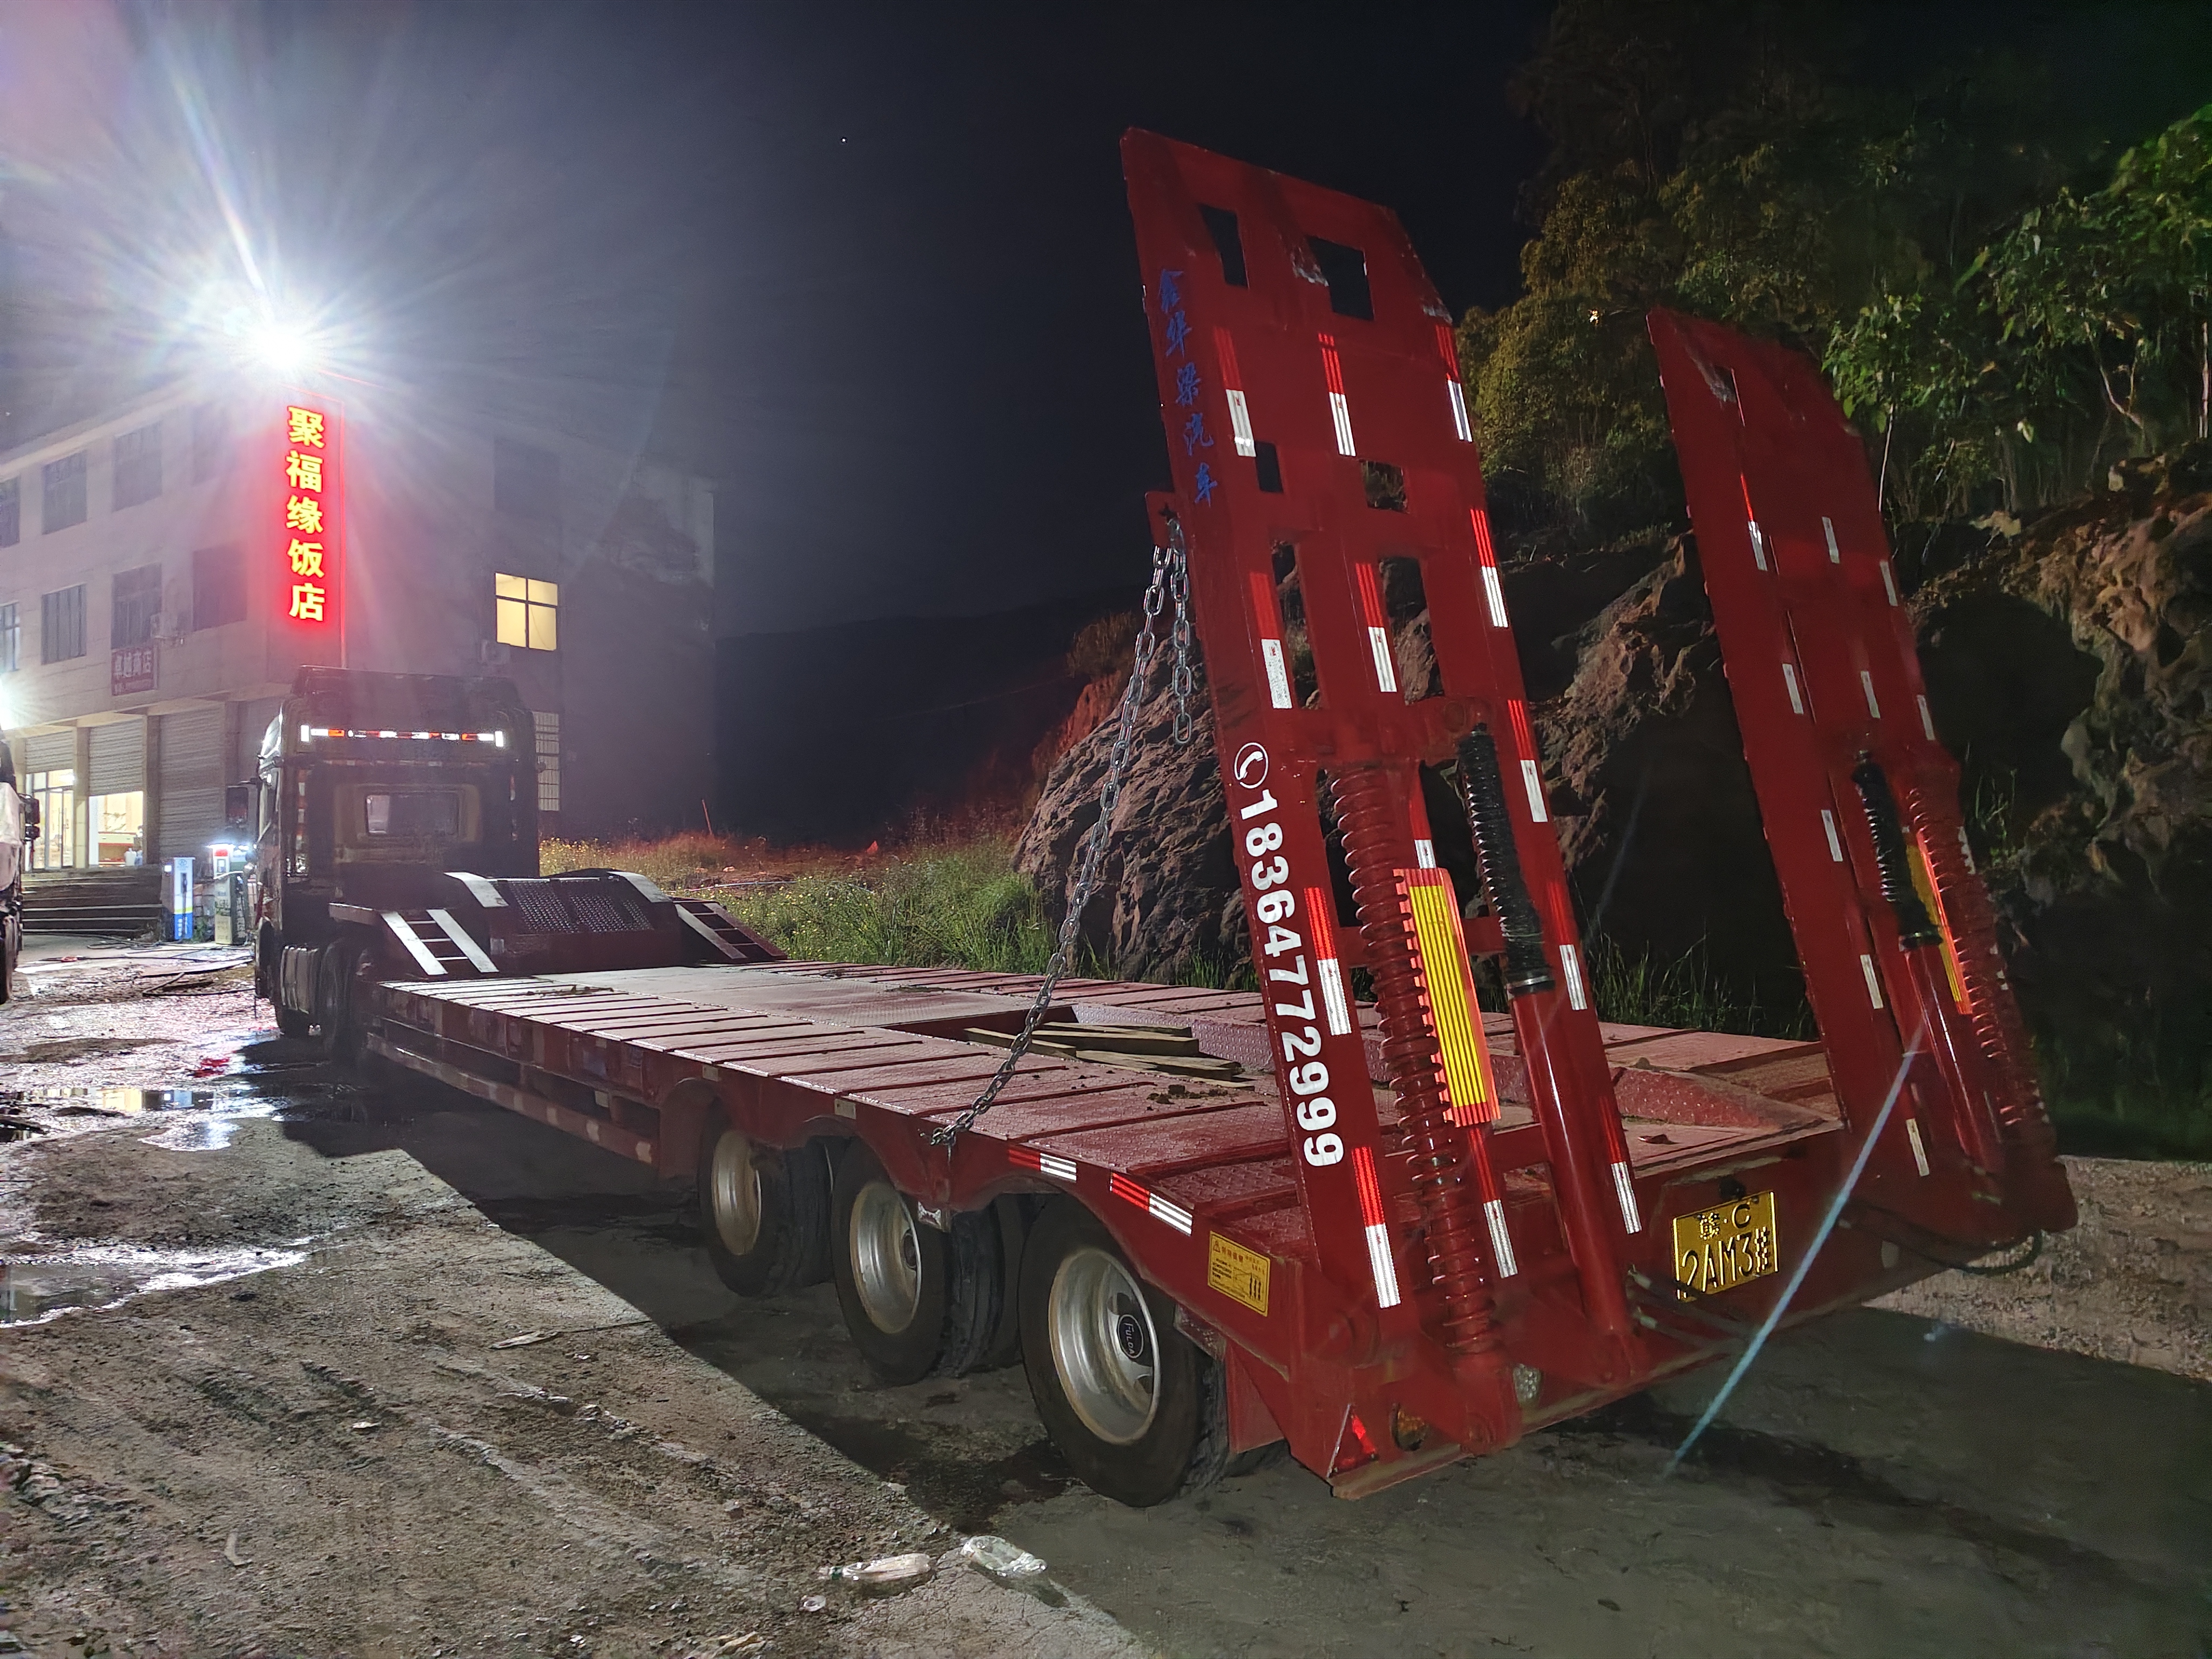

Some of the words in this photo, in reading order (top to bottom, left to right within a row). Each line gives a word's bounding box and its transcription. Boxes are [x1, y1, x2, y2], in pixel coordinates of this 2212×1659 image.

[286, 406, 325, 622] 聚福缘饭店
[1240, 788, 1345, 1168] 18364772999
